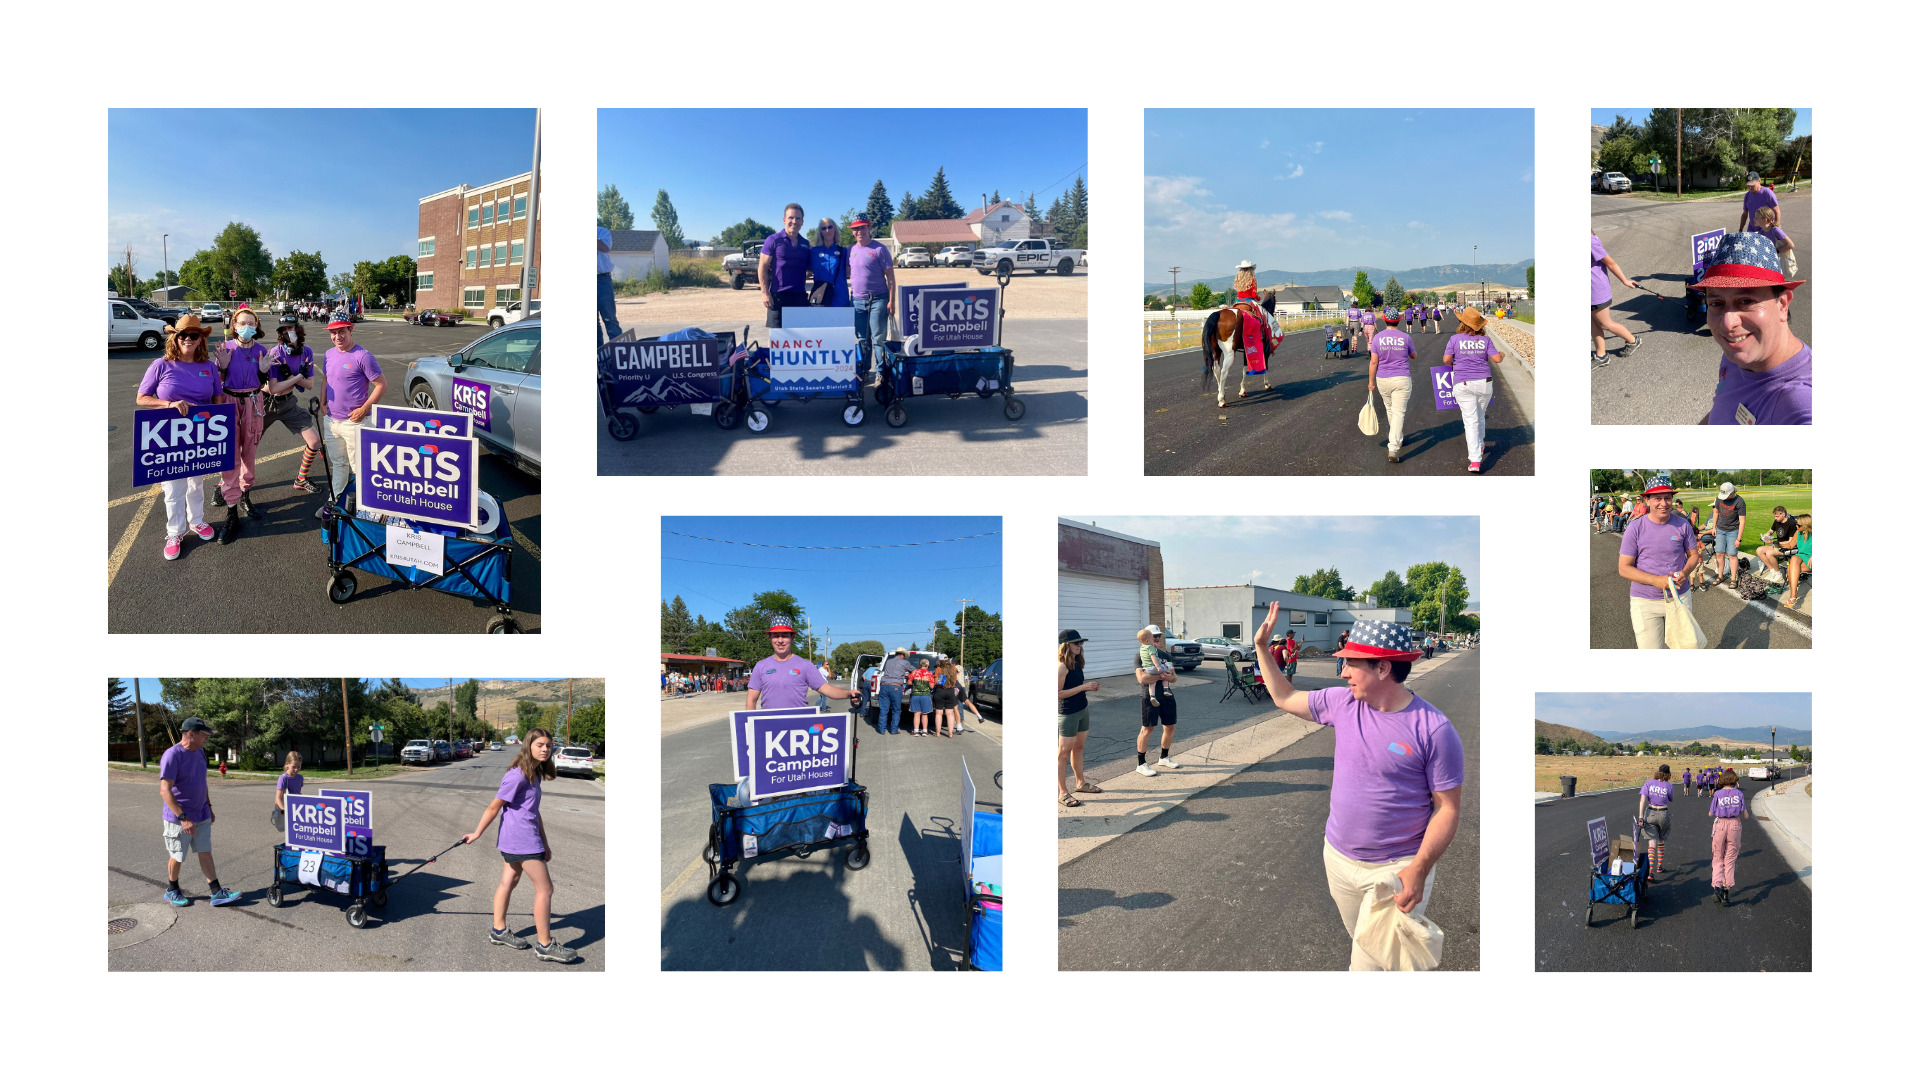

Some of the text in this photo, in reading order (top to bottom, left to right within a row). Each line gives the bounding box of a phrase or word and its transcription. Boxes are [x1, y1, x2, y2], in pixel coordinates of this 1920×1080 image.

[1017, 253, 1049, 261] EPIC
[930, 321, 987, 333] Campbell
[771, 340, 823, 348] NANCY
[614, 344, 712, 370] CAMPBELL
[771, 349, 854, 365] HUNTLY
[687, 371, 718, 379] Congress
[141, 442, 226, 466] Campbell
[147, 460, 221, 478] For Utah House
[370, 473, 459, 499] Campbell
[376, 490, 453, 511] For Utah House
[396, 540, 431, 551] CAMPBELL
[765, 754, 837, 773] Campbell
[771, 770, 833, 784] For Utah House
[345, 817, 364, 826] pbell
[292, 823, 336, 836] Campbell
[302, 860, 315, 873] 23
